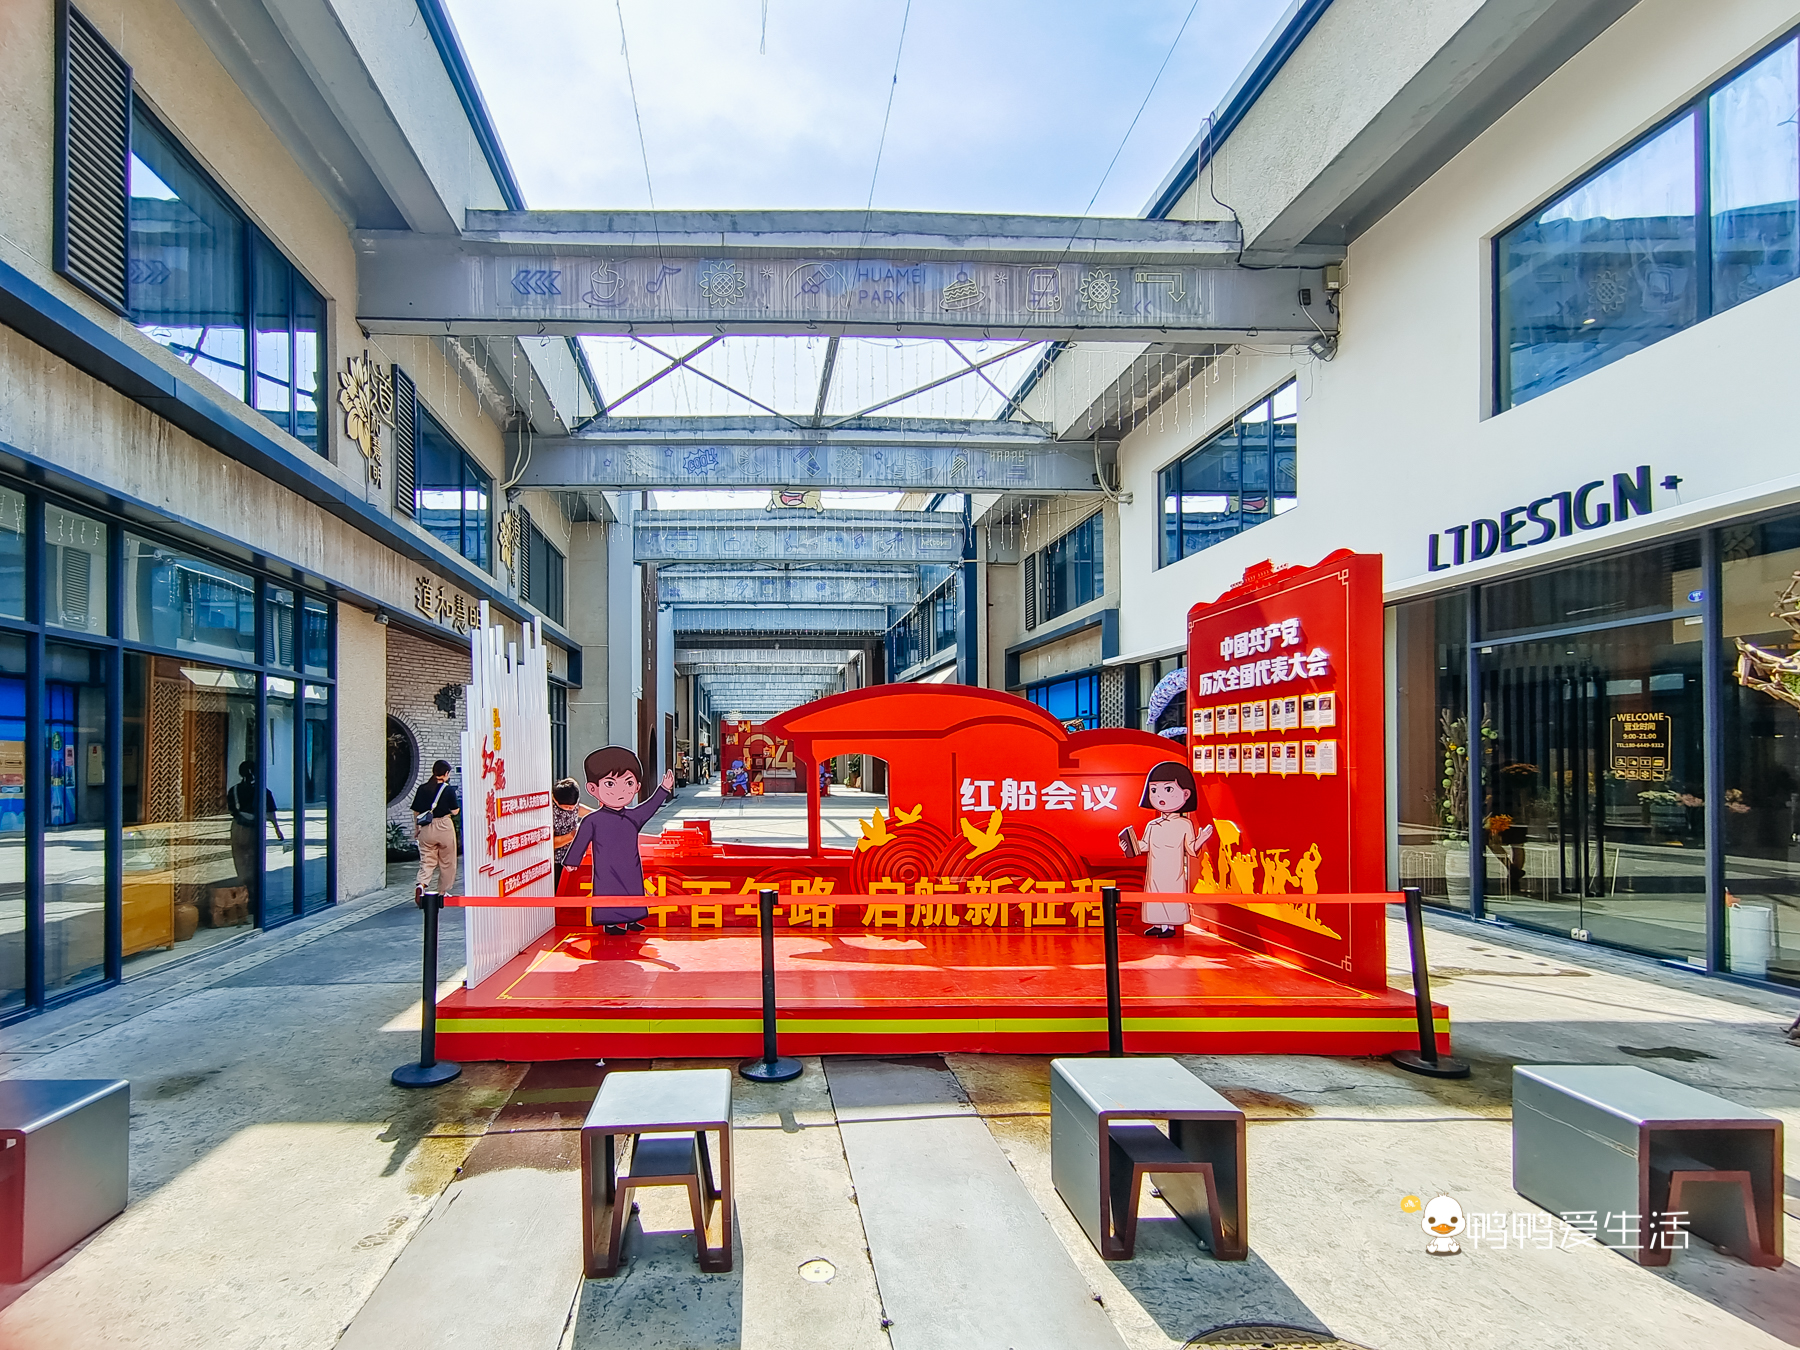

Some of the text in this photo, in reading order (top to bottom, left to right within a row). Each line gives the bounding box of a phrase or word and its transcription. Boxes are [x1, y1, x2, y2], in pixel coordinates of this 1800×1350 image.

[858, 266, 926, 285] HUAMEI
[858, 289, 906, 305] PARK
[989, 450, 1026, 463] HAPPY
[1219, 617, 1301, 662] 中国共产党
[1198, 647, 1330, 697] 历次全国代表大会
[1616, 712, 1665, 722] WELCOME
[1623, 722, 1656, 731] 营业时间
[959, 777, 1118, 812] 红船会议
[579, 876, 836, 928] 斗百年路
